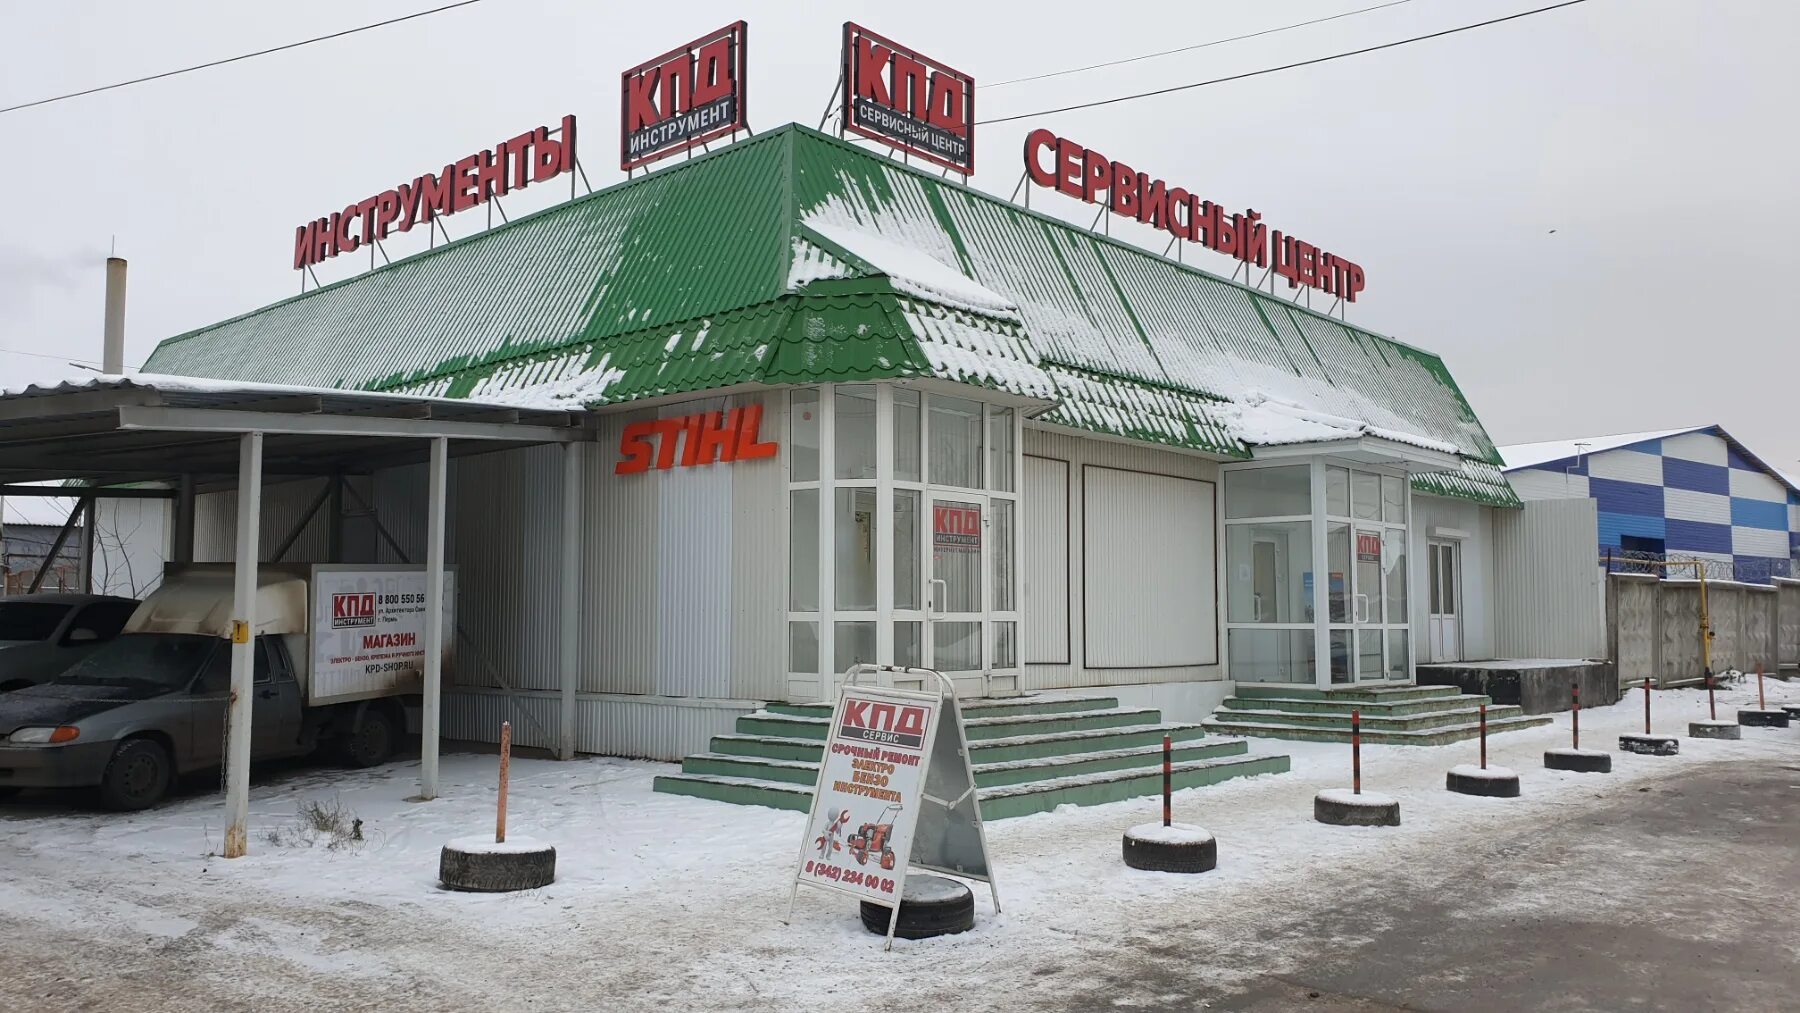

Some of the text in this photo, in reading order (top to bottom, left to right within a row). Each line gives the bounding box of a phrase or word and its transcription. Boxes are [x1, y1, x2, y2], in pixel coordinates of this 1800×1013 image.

[627, 36, 733, 133] КПД
[855, 35, 966, 138] КПД
[630, 101, 730, 154] ИНСТРУМЕНТ
[860, 104, 965, 156] СЕРВИСНЫЙ ЦЕНТР
[293, 114, 577, 270] ИНСТРУМЕНТЫ
[1023, 128, 1365, 302] СЕРВИСНЫЙ ЦЕНТР
[615, 404, 778, 474] STIHL
[935, 509, 979, 535] КПД
[334, 595, 374, 617] КПД
[378, 593, 425, 604] 8 800 550 56
[334, 617, 373, 626] ИНСТРУМЕНТ
[363, 633, 416, 649] МАГАЗИН
[365, 661, 414, 674] KPD-SHOP.RU
[843, 700, 925, 735] КПД
[863, 730, 900, 743] СЕРВИС
[832, 743, 920, 766] СРОЧНЫЙ РЕМОНТ
[852, 758, 895, 775] ЭЛЕКТРО
[852, 771, 889, 787] БЕНЗО
[833, 781, 902, 802] ИНСТРУМЕНТА
[805, 860, 895, 893] 8 (342) 234 00 02
